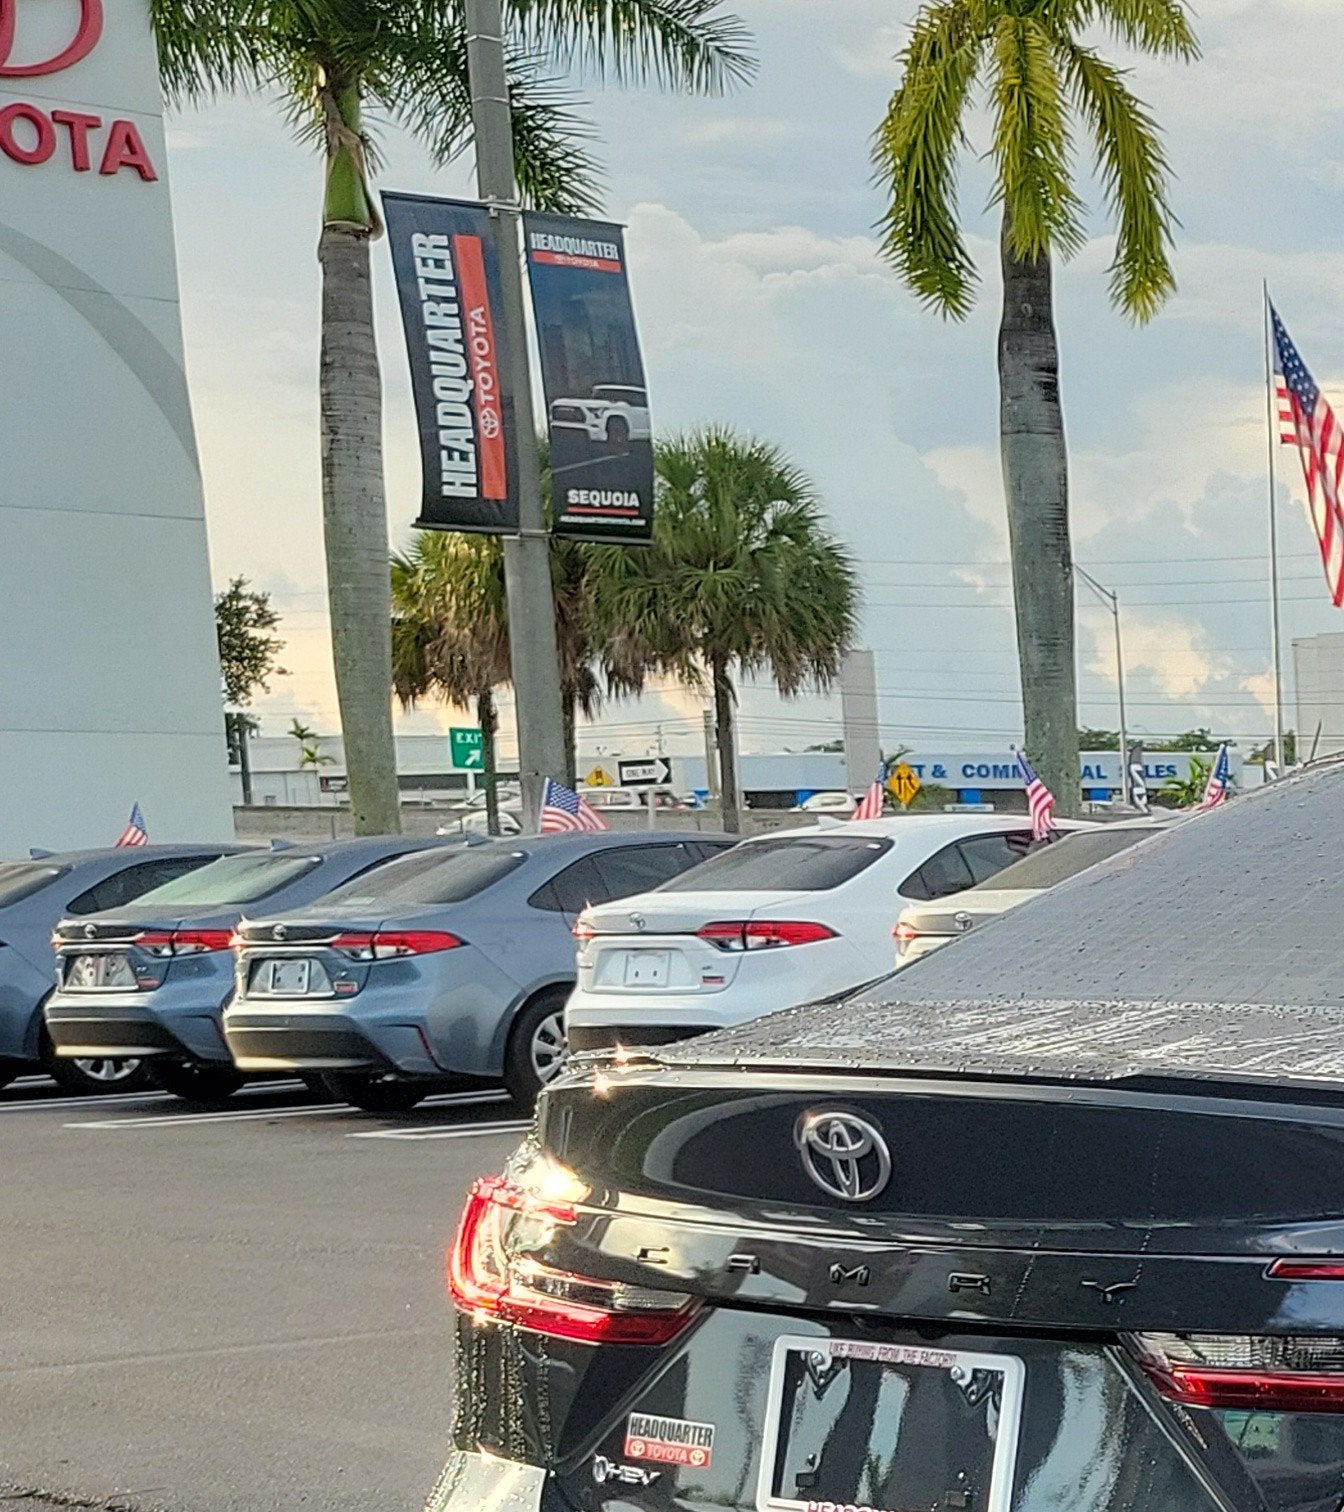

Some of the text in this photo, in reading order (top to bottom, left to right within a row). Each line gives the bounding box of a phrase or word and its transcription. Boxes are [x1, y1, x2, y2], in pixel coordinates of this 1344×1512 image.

[530, 232, 619, 260] HEADQUARTER
[411, 232, 478, 499] HEADQUARTER
[469, 306, 495, 404] TOYOTA
[567, 489, 640, 507] SEQUOIA
[629, 1416, 713, 1447] HEADQUARTER
[646, 1443, 688, 1461] TOYOTA
